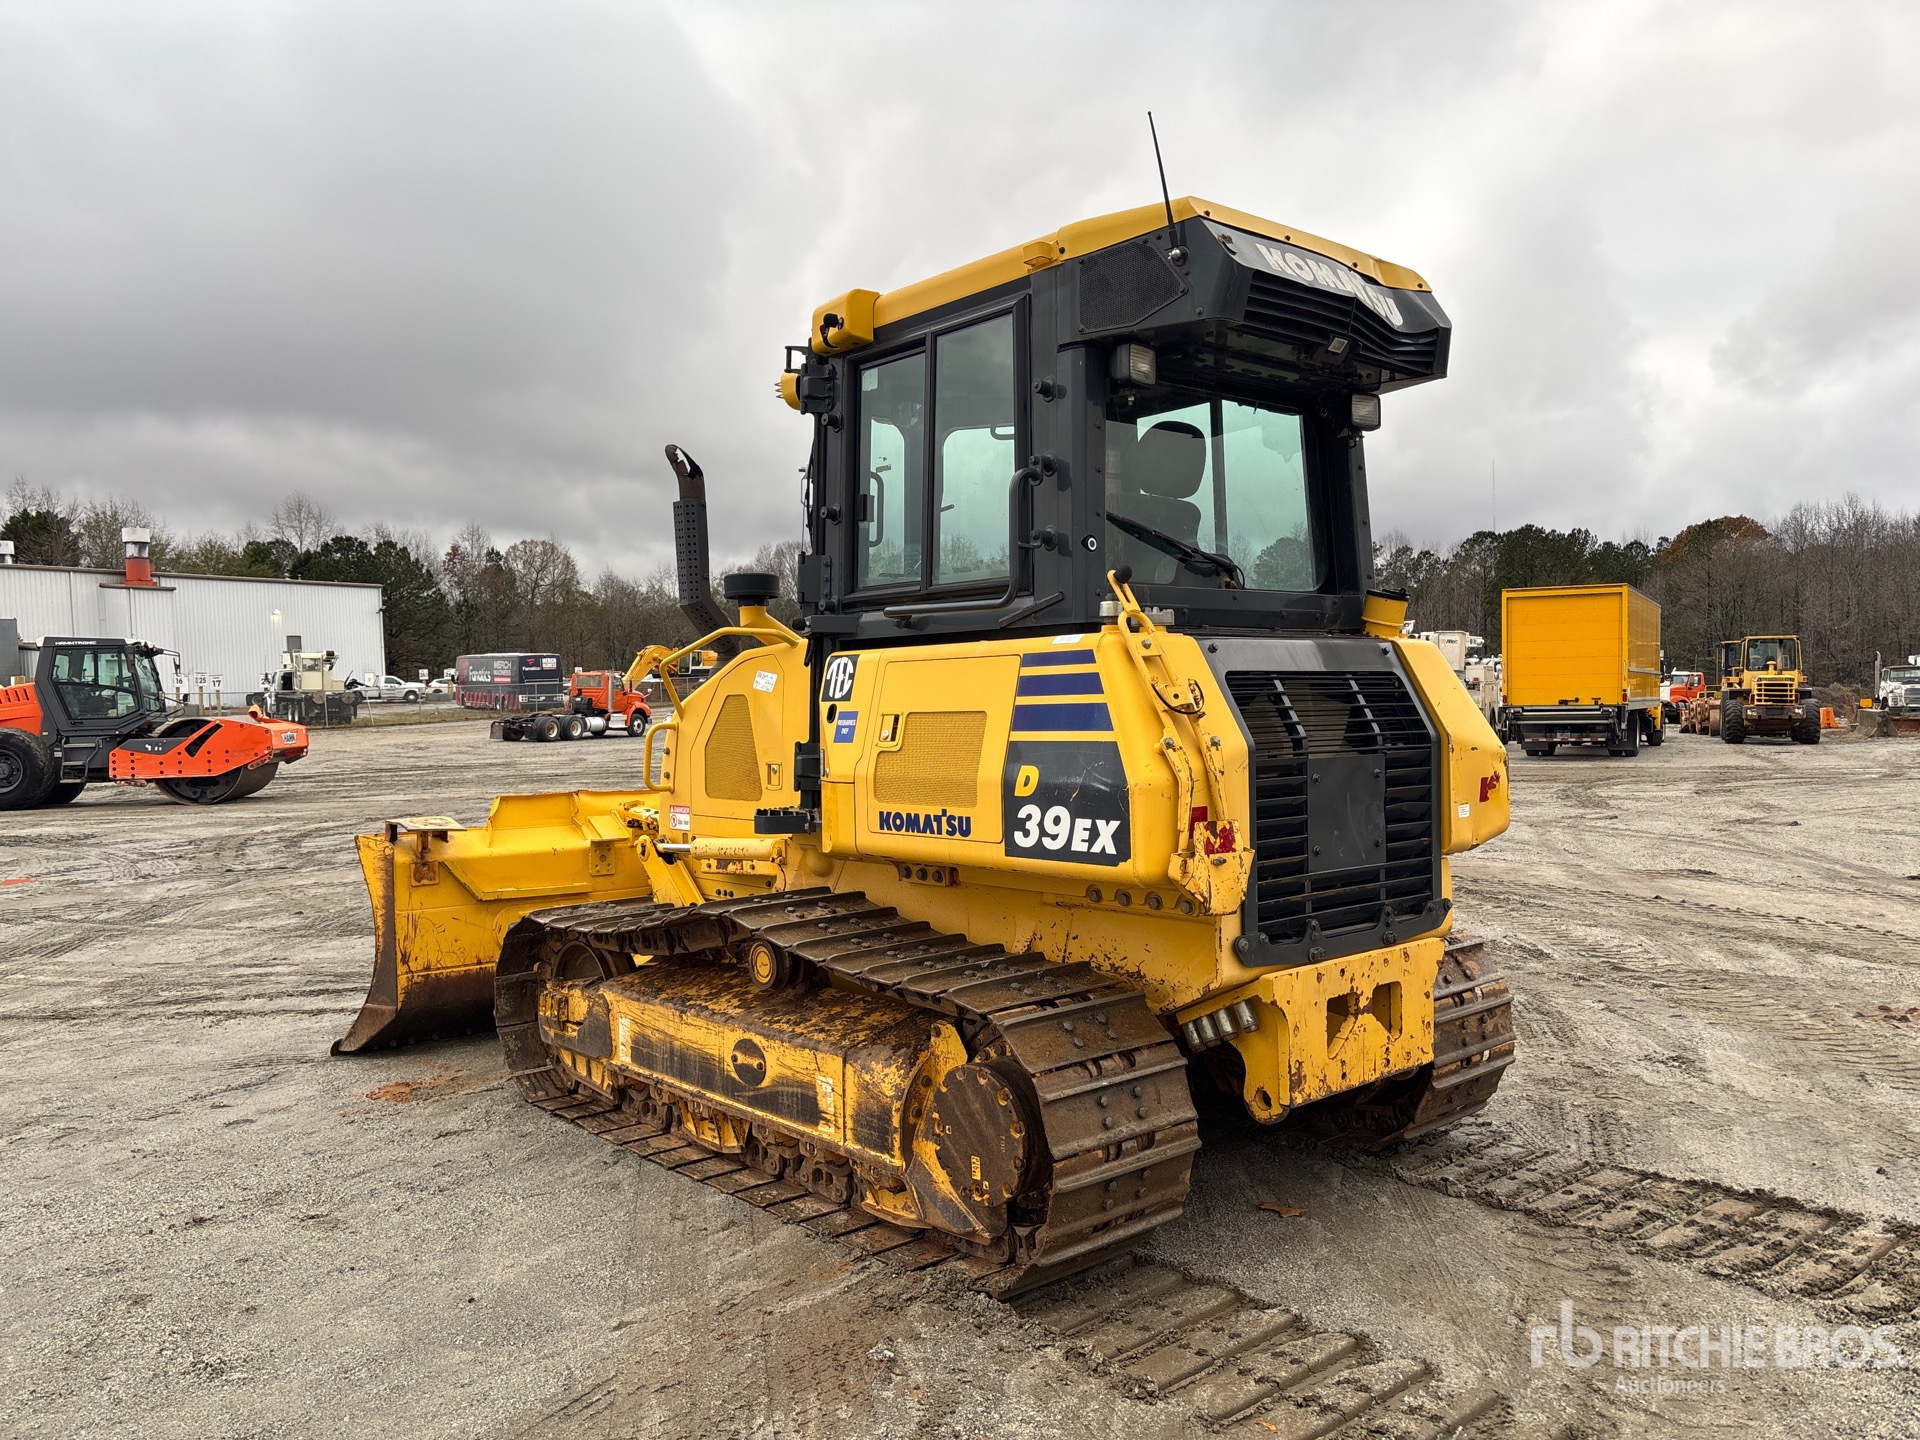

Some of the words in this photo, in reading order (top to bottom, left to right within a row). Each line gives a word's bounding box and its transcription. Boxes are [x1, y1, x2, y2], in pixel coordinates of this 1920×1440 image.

[1255, 243, 1404, 326] KOMATSU
[469, 666, 491, 682] Fanatics
[493, 661, 511, 669] MERCH
[826, 657, 854, 699] TEC
[1014, 765, 1040, 797] D
[879, 808, 971, 837] KOMATSU
[1014, 804, 1121, 855] 39EX
